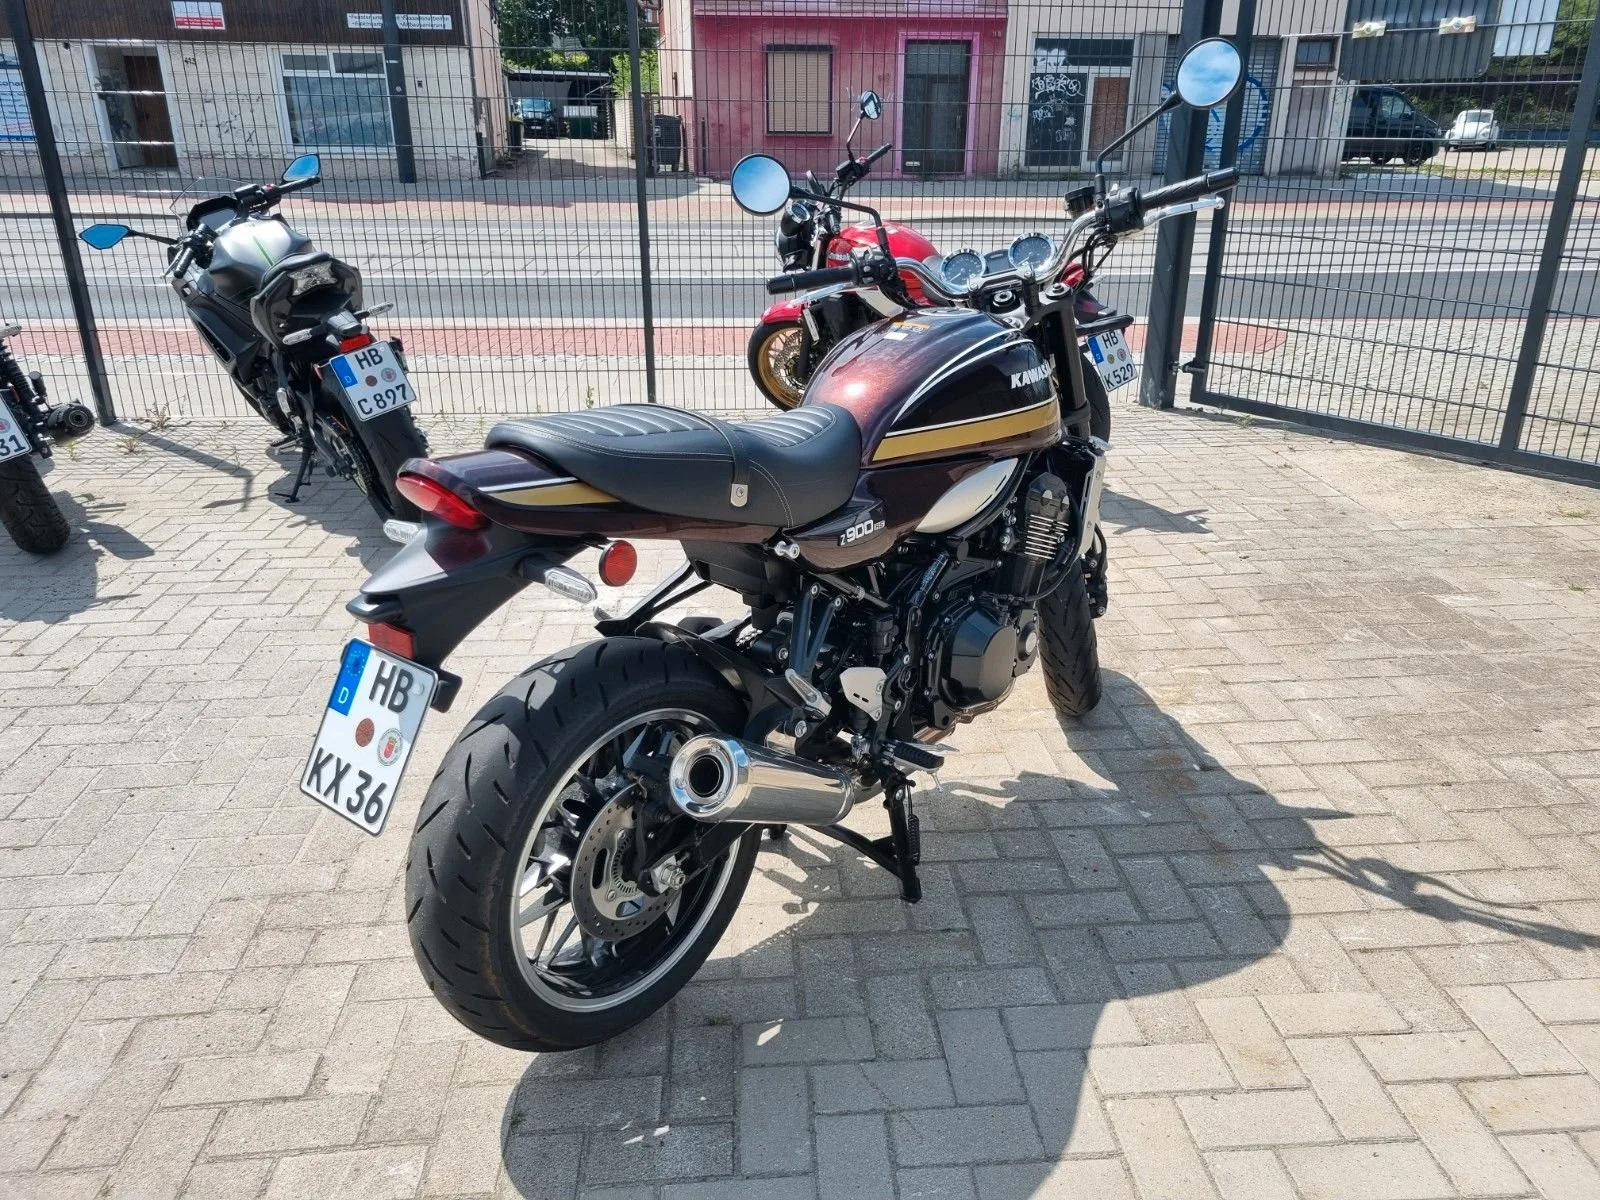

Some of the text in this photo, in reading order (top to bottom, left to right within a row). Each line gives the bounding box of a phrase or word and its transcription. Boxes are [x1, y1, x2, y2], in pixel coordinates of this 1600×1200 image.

[1102, 331, 1118, 349] HB
[355, 348, 383, 370] HB
[338, 687, 349, 704] D
[368, 660, 414, 713] HB
